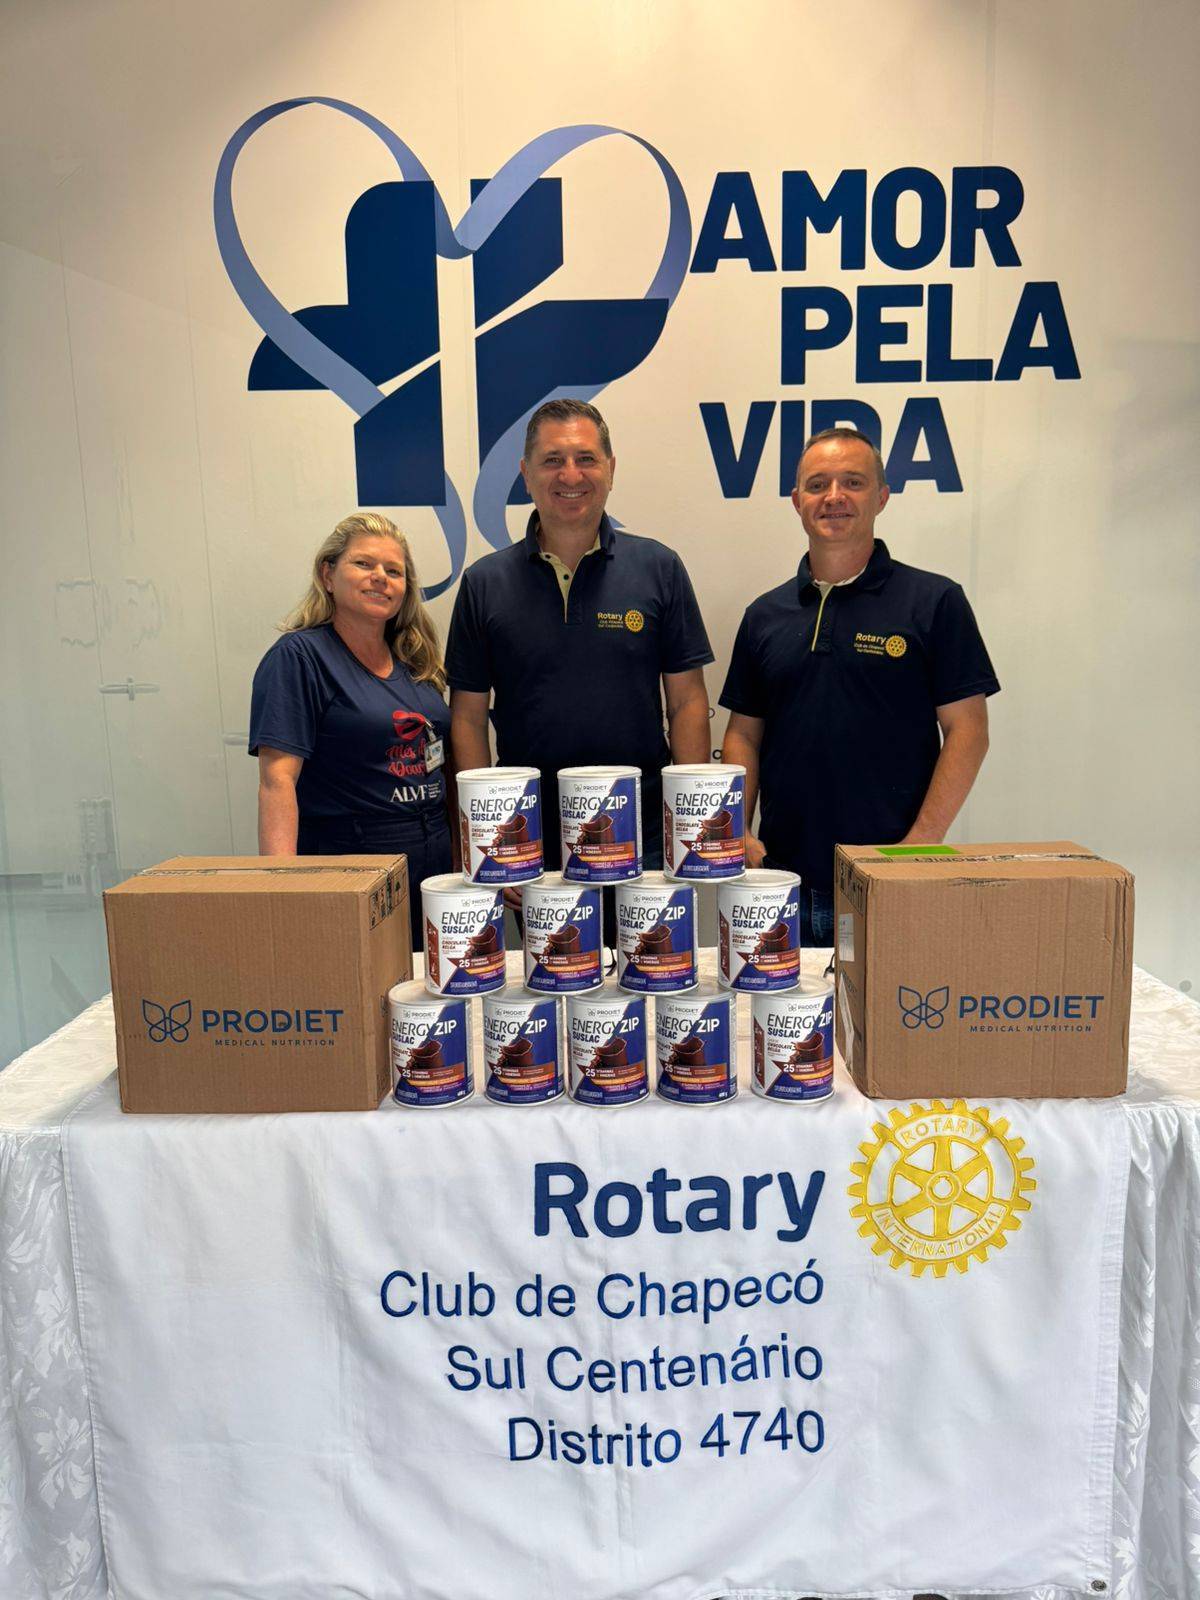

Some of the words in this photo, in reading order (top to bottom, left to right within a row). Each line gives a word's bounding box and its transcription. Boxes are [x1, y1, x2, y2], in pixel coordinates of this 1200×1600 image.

[689, 166, 1025, 273] AMOR
[780, 281, 1081, 385] PELA
[597, 612, 623, 621] Rotary
[855, 632, 887, 644] Rotary
[676, 807, 708, 816] SUSLAC
[471, 813, 502, 822] SUSLAC
[487, 847, 498, 856] 25
[572, 845, 582, 854] 25
[691, 842, 702, 851] 25
[732, 918, 766, 928] SUSLAC
[442, 925, 474, 934] SUSLAC
[459, 958, 470, 968] 25
[539, 955, 549, 964] 25
[630, 954, 640, 964] 25
[748, 954, 760, 964] 25
[959, 995, 1104, 1019] PRODIET
[202, 1009, 344, 1033] PRODIET
[768, 1027, 800, 1038] SUSLAC
[585, 1068, 596, 1077] 25
[664, 1062, 674, 1073] 25
[784, 1064, 795, 1073] 25
[402, 1068, 411, 1078] 25
[899, 1116, 980, 1145] ROTARY
[534, 1162, 826, 1242] Rotary
[876, 1208, 1005, 1256] INTERNATIONAL
[380, 1270, 496, 1318] Club
[516, 1274, 576, 1318] de
[597, 1258, 824, 1324] Chapecó
[446, 1346, 526, 1391] Sul
[546, 1332, 824, 1394] Centenário
[508, 1417, 682, 1467] Distrito
[700, 1408, 825, 1458] 4740
